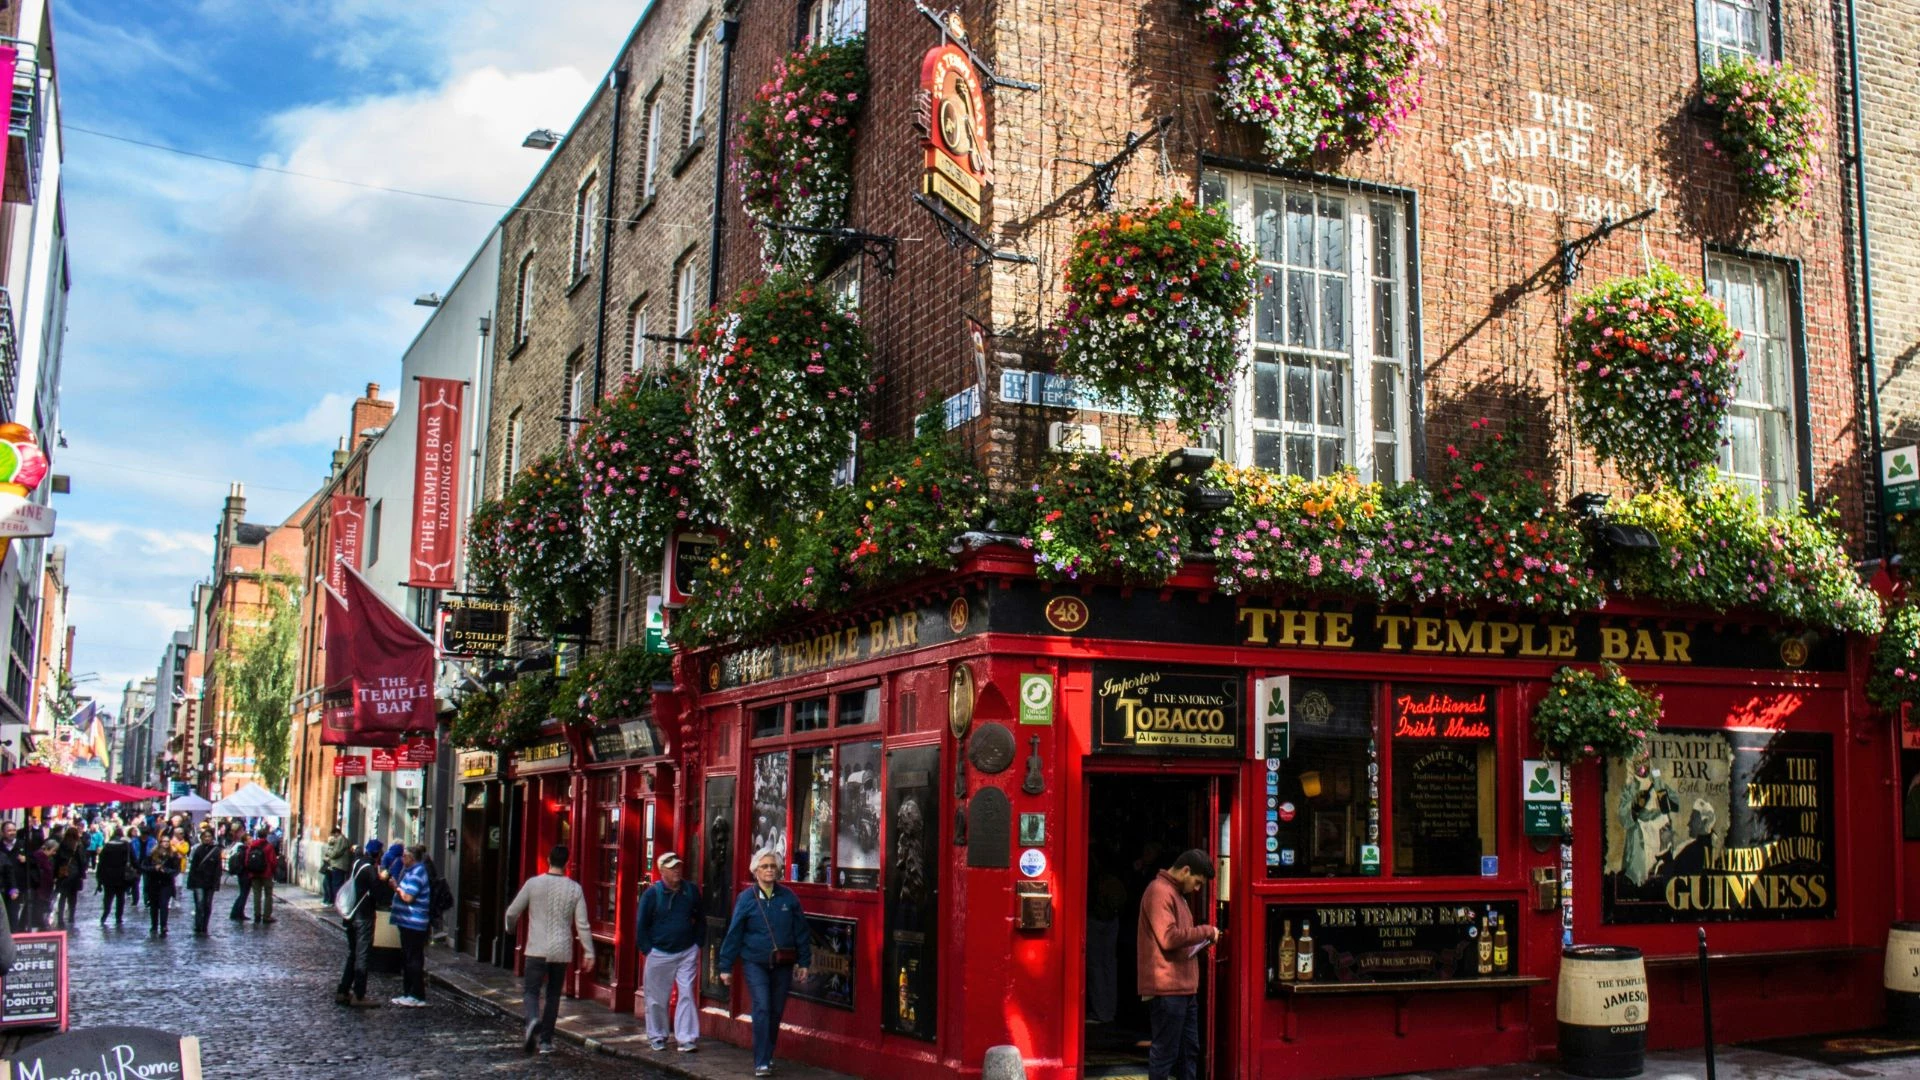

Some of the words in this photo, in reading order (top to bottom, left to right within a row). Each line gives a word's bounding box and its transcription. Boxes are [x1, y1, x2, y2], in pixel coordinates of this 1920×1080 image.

[1529, 90, 1594, 131] THE
[1451, 128, 1591, 172] TEMPLE
[1603, 146, 1667, 210] BAR
[427, 416, 441, 447] BAR
[423, 450, 439, 514] TEMPLE
[439, 467, 451, 530] TRADING
[345, 522, 357, 545] THE
[421, 521, 435, 553] THE
[448, 600, 465, 609] THE
[468, 601, 501, 611] TEMPLE
[953, 603, 966, 627] 48
[1054, 602, 1080, 623] 48
[466, 641, 498, 650] STORE
[781, 626, 859, 673] TEMPLE
[870, 611, 919, 653] BAR
[1239, 608, 1355, 647] THE
[1376, 615, 1578, 658] TEMPLE
[1600, 627, 1692, 662] BAR
[379, 677, 408, 687] THE
[1099, 672, 1160, 698] Importers
[1138, 687, 1149, 695] OF
[358, 685, 428, 702] TEMPLE
[1154, 693, 1176, 703] FINE
[1178, 694, 1224, 705] SMOKING
[1398, 693, 1486, 715] Traditional
[376, 701, 413, 714] BAR
[1116, 698, 1224, 738] TOBACCO
[1395, 716, 1436, 737] Irish
[1444, 716, 1490, 737] Music
[1138, 734, 1179, 744] Always
[1186, 735, 1196, 743] in
[1200, 734, 1233, 745] Stock
[1647, 740, 1728, 760] TEMPLE
[1413, 750, 1454, 771] TEMPLE
[1672, 761, 1711, 781] BAR
[1786, 757, 1817, 781] THE
[1747, 783, 1818, 808] EMPEROR
[1801, 811, 1818, 834] OF
[1703, 846, 1763, 872] MALTED
[1765, 836, 1824, 867] LIQUORS
[1665, 874, 1828, 910] GUINNESS
[1317, 907, 1357, 927] THE
[1361, 907, 1434, 926] TEMPLE
[1379, 927, 1417, 937] DUBLIN
[1361, 957, 1380, 967] LIVE
[1382, 957, 1407, 966] MUSIC
[1409, 956, 1433, 965] DAILY
[1597, 980, 1614, 988] THE
[6, 996, 55, 1008] DONUTS
[112, 1044, 180, 1080] Rome
